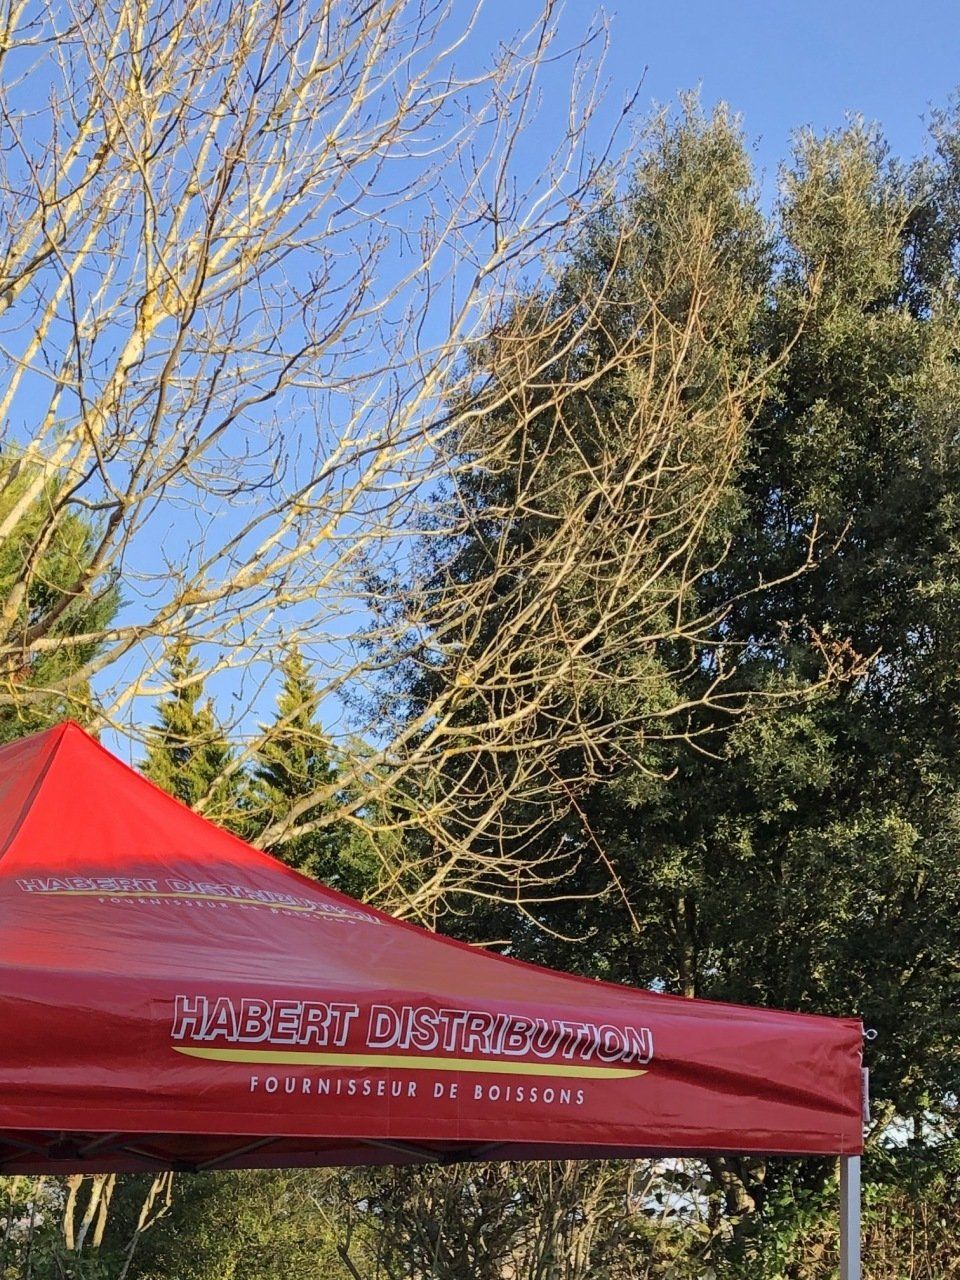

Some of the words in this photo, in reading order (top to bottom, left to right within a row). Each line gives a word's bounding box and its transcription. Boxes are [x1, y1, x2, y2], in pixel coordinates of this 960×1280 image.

[16, 878, 159, 893] HABERT
[171, 995, 358, 1047] HABERT
[366, 1005, 655, 1064] DISTRIBUTION
[250, 1076, 417, 1098] FOURNISSEUR
[434, 1083, 458, 1098] DE
[474, 1085, 586, 1105] BOISSONS
